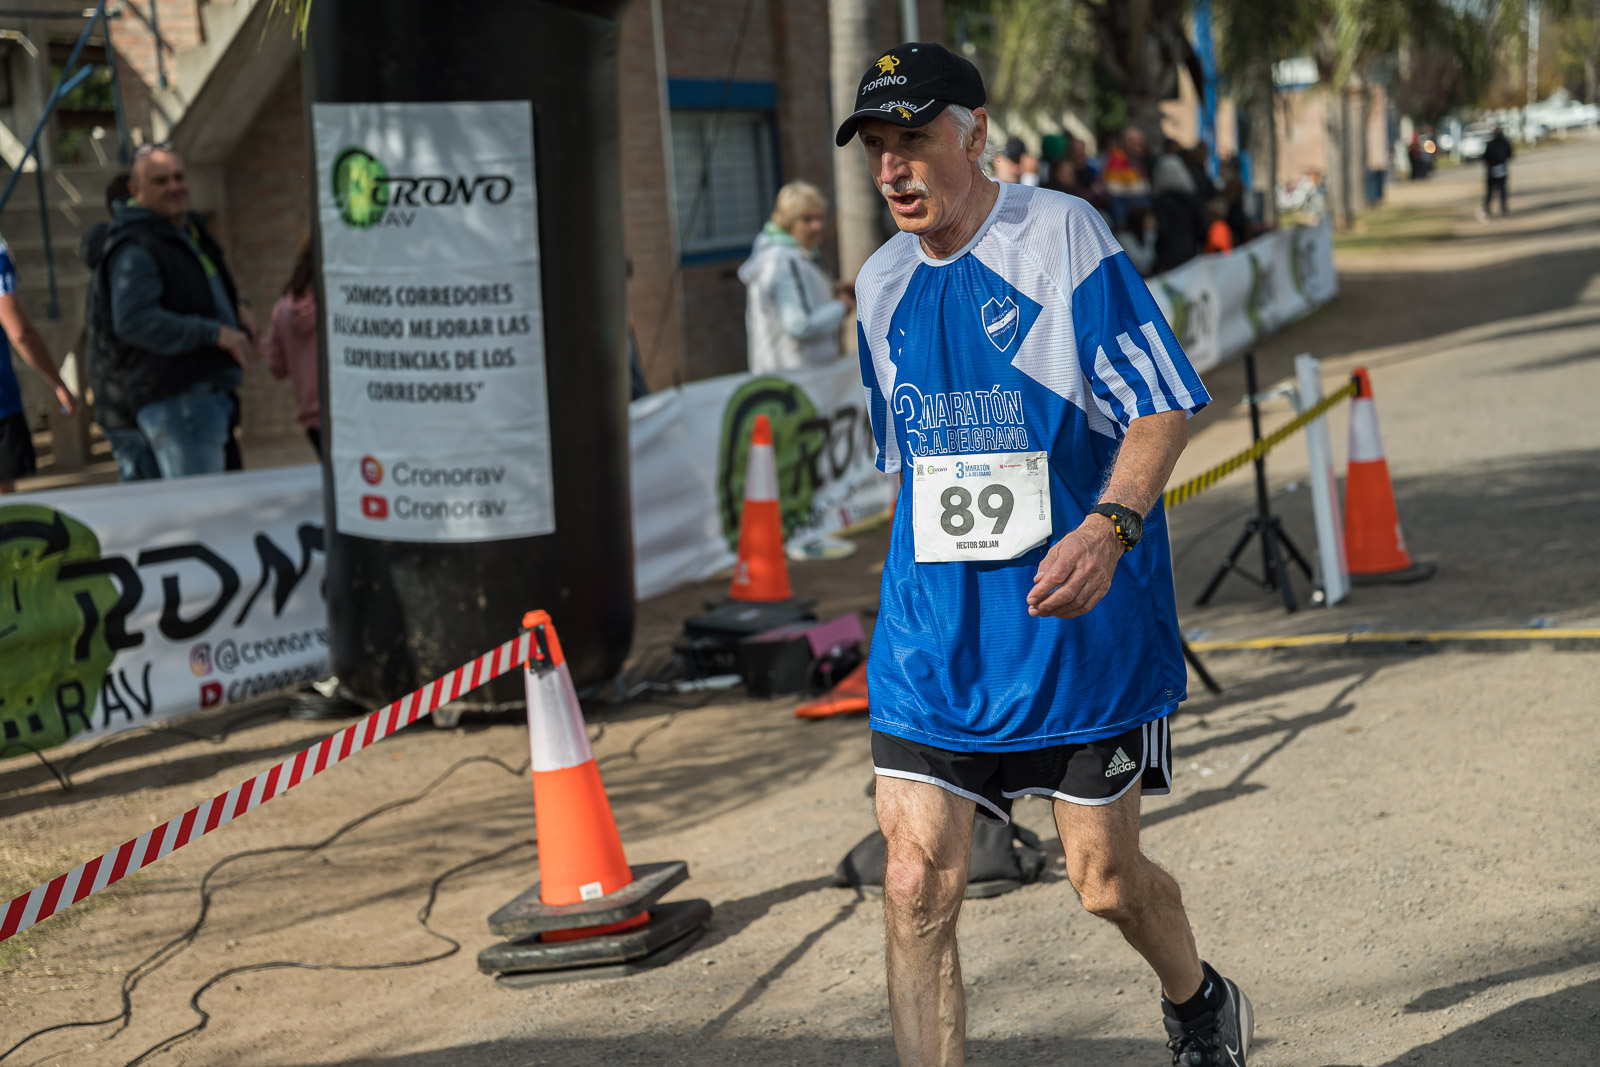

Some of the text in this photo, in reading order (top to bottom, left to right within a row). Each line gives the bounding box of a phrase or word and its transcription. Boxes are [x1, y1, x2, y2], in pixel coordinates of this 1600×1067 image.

[862, 75, 907, 95] TORINO
[880, 100, 917, 110] TORINO
[371, 211, 416, 228] RAV
[396, 283, 513, 307] CORREDORES
[333, 314, 531, 338] BUSCANDO MEJORAR LAS
[344, 347, 516, 371] EXPERIENCIAS DE LOS
[921, 384, 1024, 430] MARATÓN
[391, 461, 506, 487] Cronorav
[955, 461, 964, 479] 3
[393, 495, 507, 520] Cronorav
[940, 484, 1014, 536] 89
[956, 540, 999, 549] HECTOR SOLJAN
[57, 663, 152, 738] RAV
[1105, 761, 1136, 778] adidas
